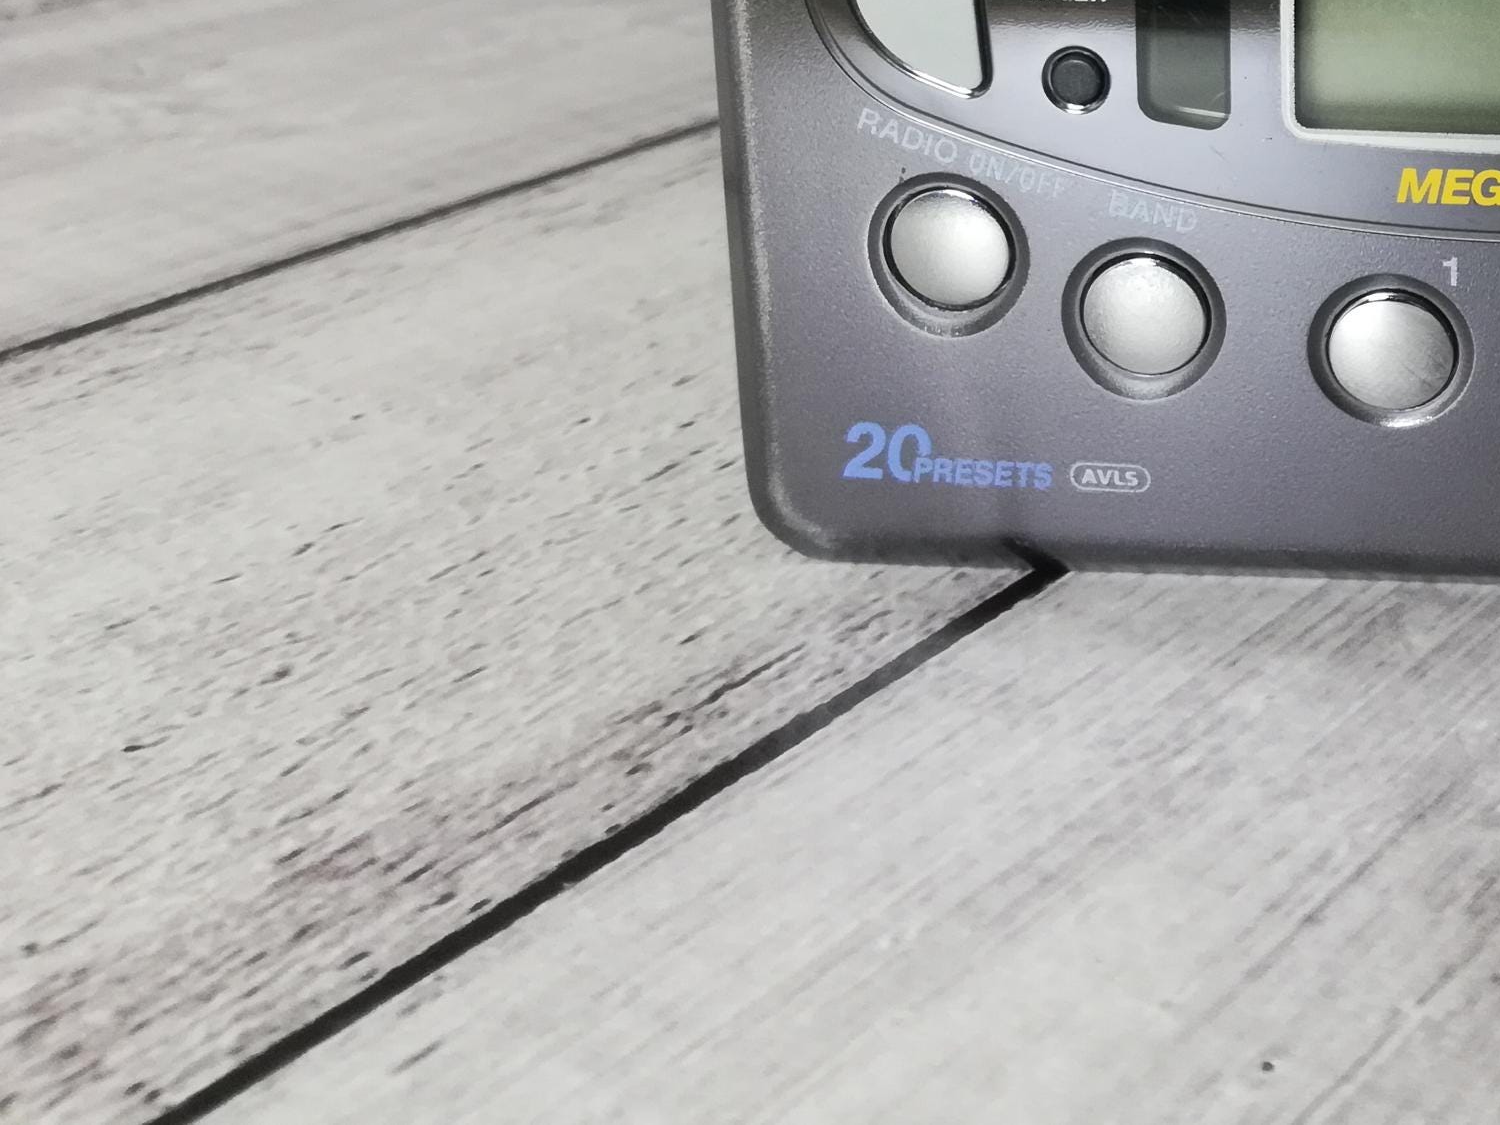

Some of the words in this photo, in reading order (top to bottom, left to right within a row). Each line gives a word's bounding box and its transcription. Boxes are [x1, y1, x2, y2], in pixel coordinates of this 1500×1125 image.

[856, 107, 959, 164] RADIO
[969, 151, 1069, 199] ON/OFF
[1107, 189, 1199, 234] BAND
[1442, 256, 1459, 287] 1
[842, 421, 932, 483] 20
[912, 457, 1053, 491] PRESETS
[1081, 469, 1140, 487] AVLS
